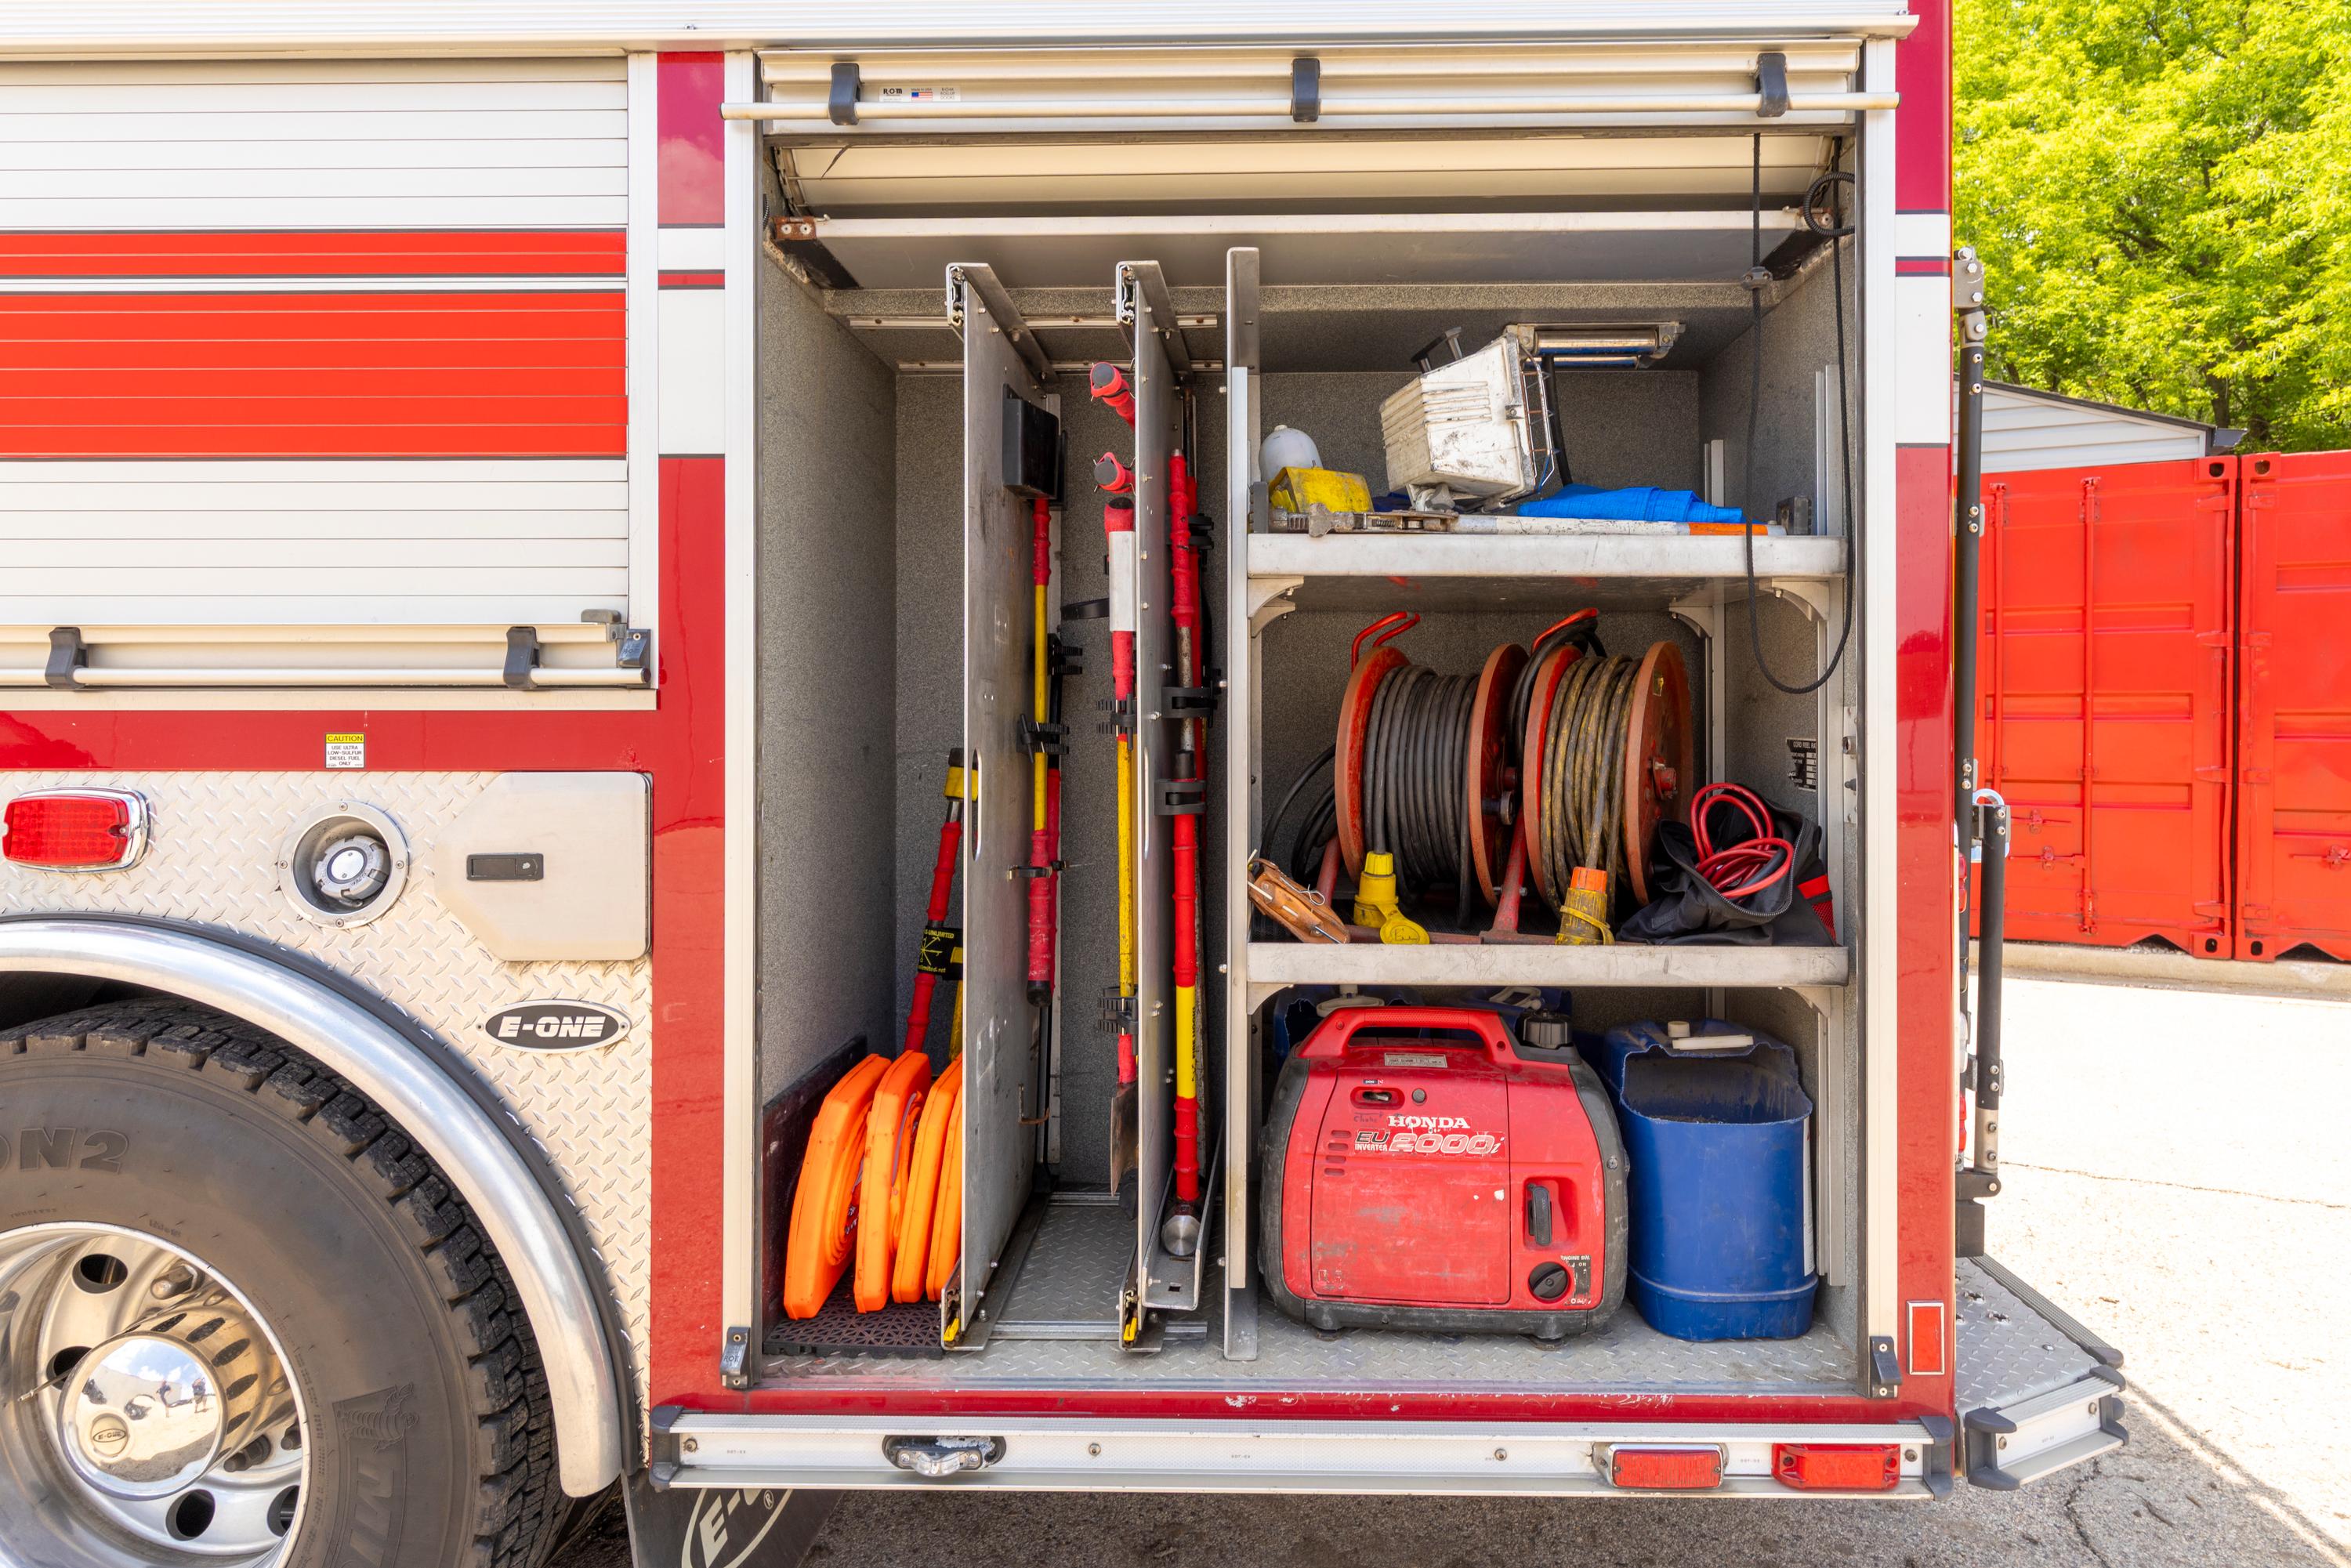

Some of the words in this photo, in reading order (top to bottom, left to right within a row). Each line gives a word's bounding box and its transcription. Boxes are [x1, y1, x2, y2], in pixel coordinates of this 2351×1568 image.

[928, 929, 955, 939] UNLIMITED
[498, 1016, 606, 1037] E-ONE
[1388, 1115, 1470, 1129] HONDA
[1354, 1143, 1388, 1152] INVERTER
[1355, 1132, 1390, 1144] EU
[1389, 1133, 1505, 1155] 2000i
